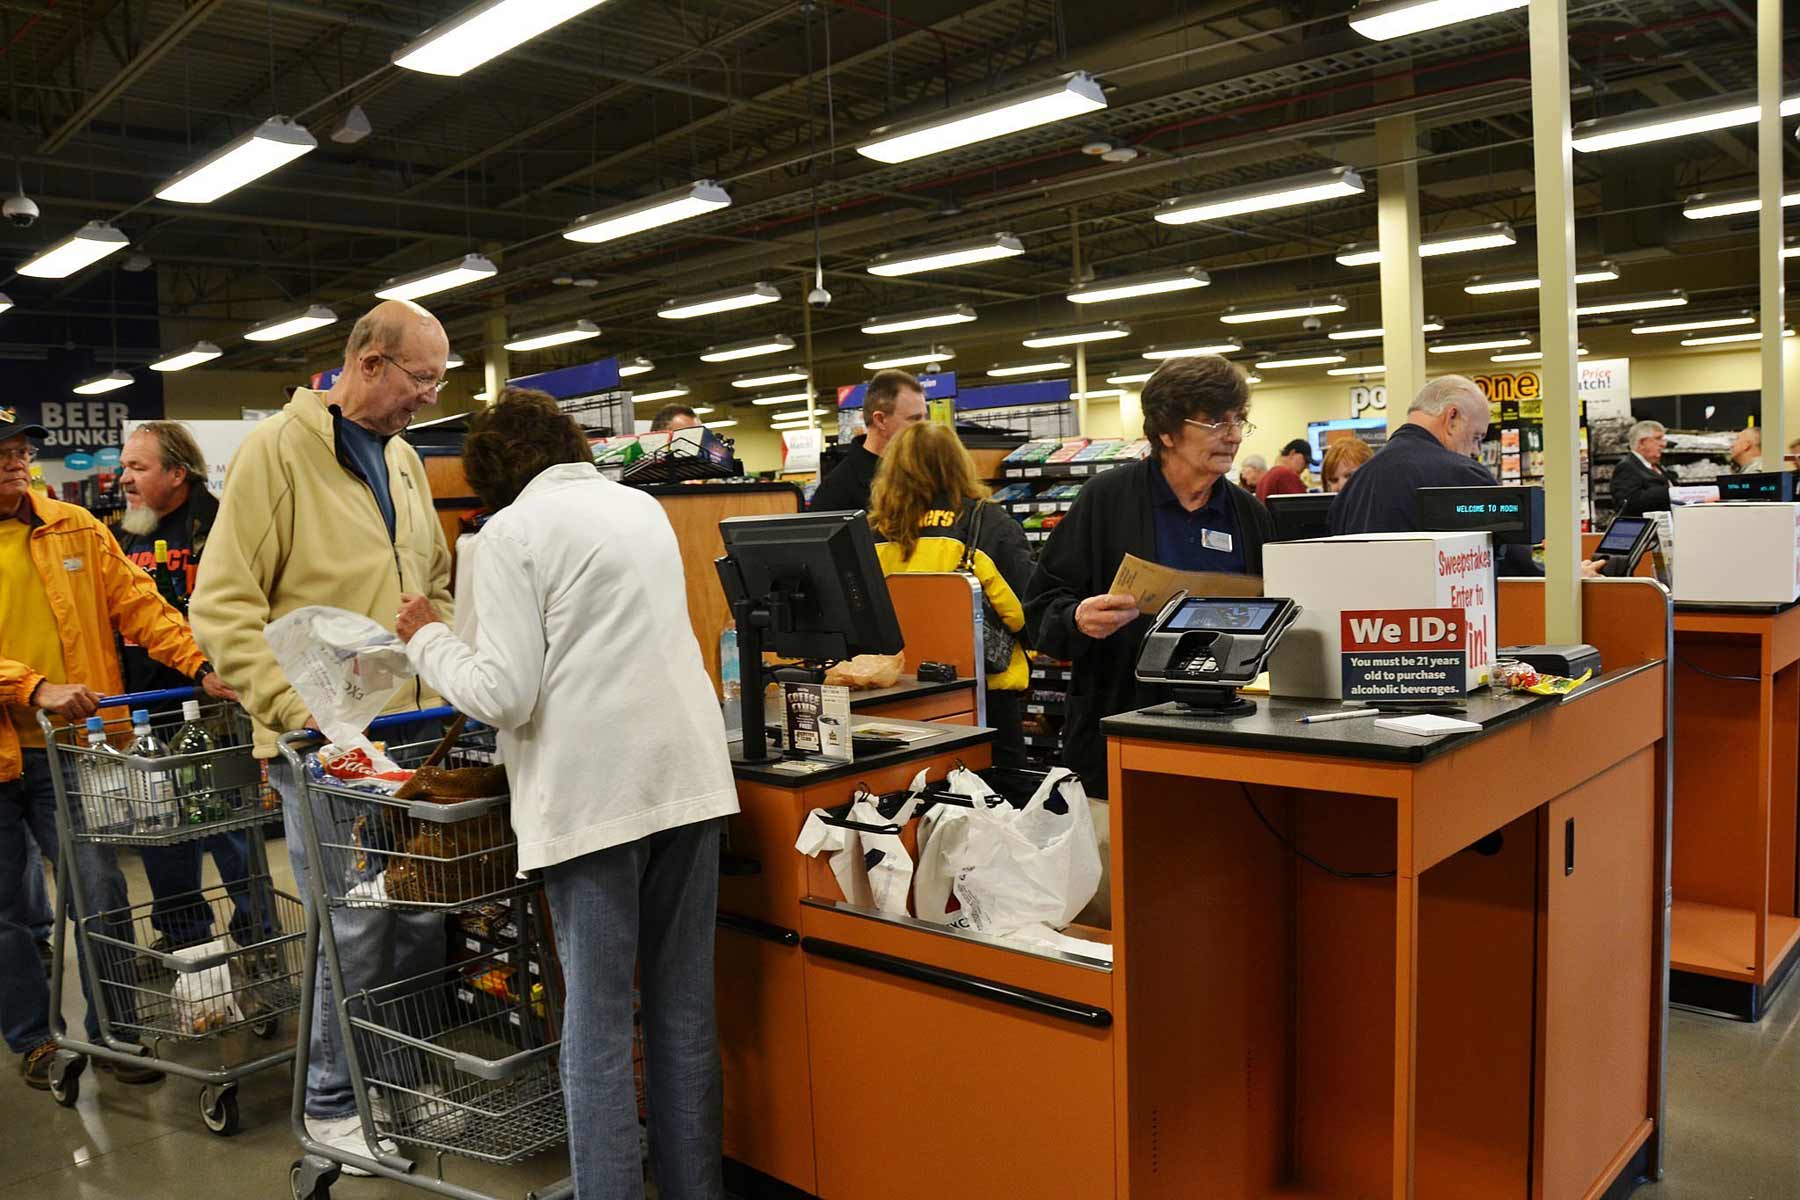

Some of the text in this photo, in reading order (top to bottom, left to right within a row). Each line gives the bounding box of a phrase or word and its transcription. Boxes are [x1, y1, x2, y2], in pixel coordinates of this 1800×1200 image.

[41, 401, 128, 429] BEER
[43, 428, 124, 446] BUNKE
[1456, 504, 1485, 513] WELCOME
[1488, 504, 1497, 512] TO
[1451, 584, 1484, 608] Enter to
[1349, 616, 1457, 644] We ID:
[1465, 614, 1488, 669] in!
[1350, 656, 1460, 668] You must be 21 years
[1364, 670, 1447, 682] old to purchase
[1351, 684, 1460, 696] alcoholic beverages.
